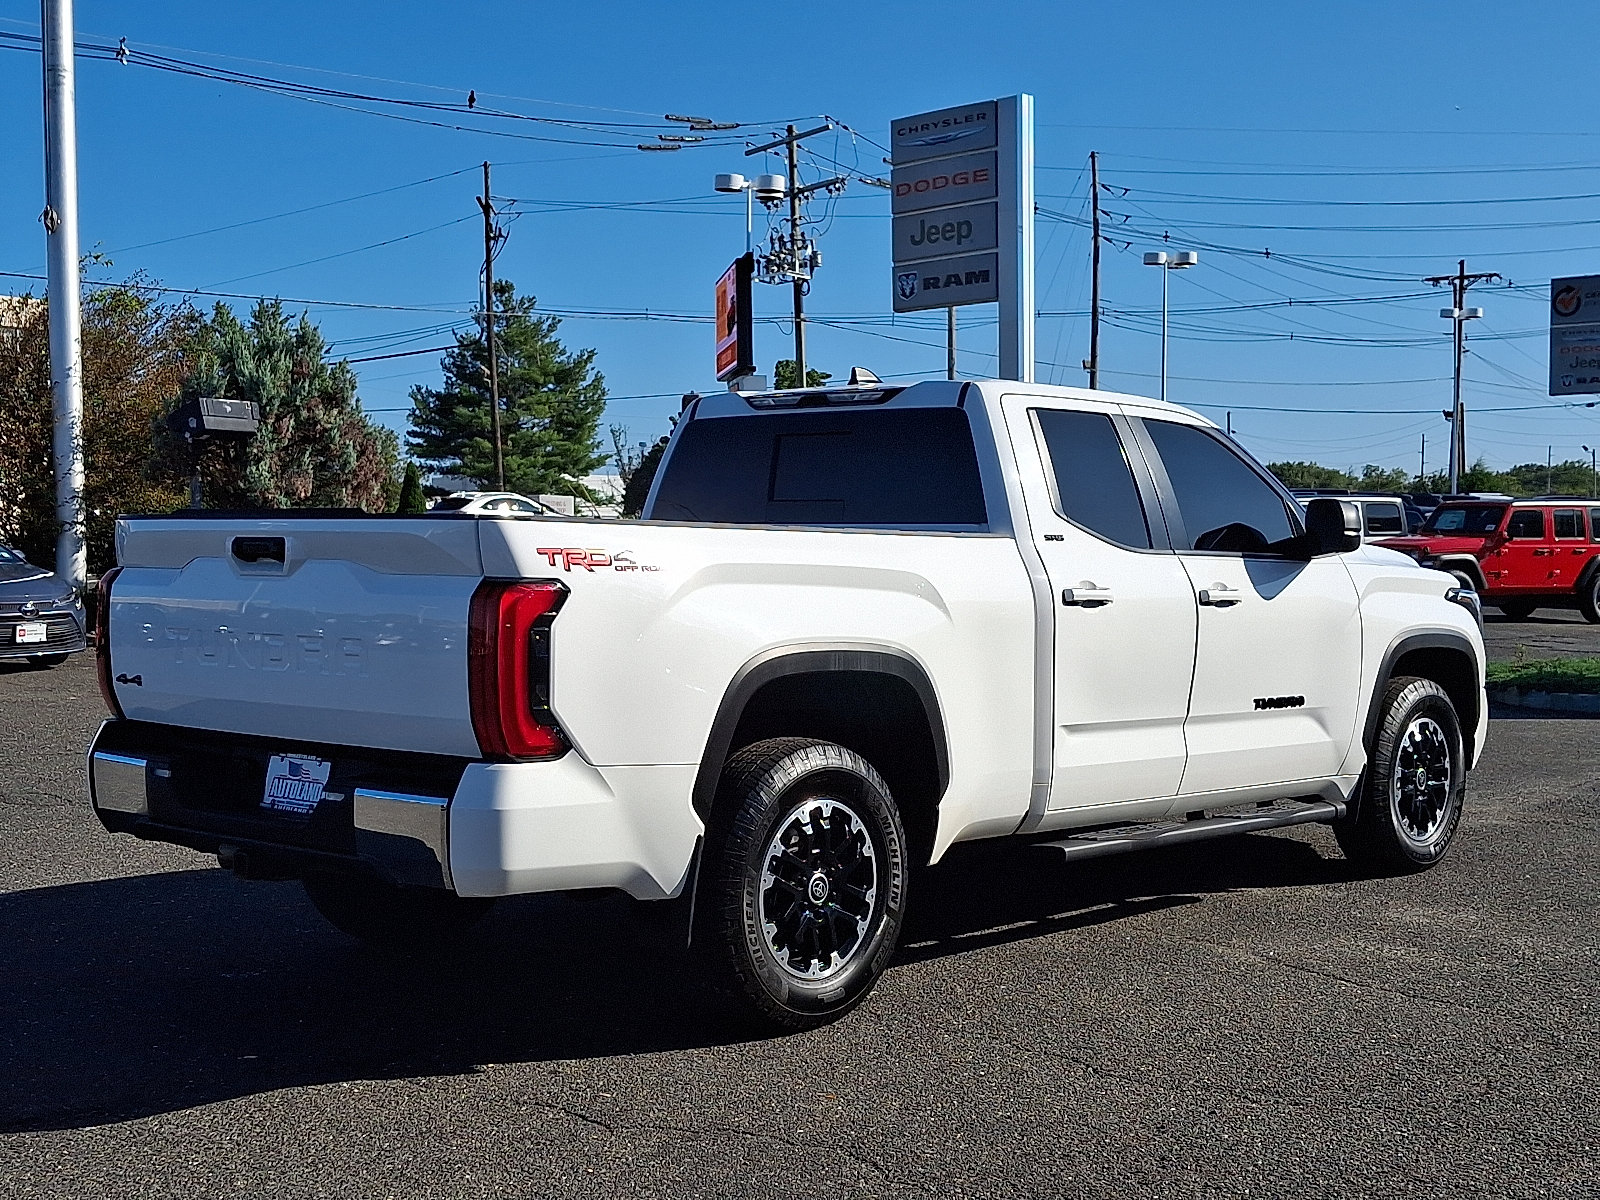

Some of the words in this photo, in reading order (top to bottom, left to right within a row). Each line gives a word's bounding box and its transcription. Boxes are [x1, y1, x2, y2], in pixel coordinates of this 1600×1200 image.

[896, 112, 987, 137] CHRYSLER
[896, 168, 990, 197] DODGE
[910, 219, 973, 246] Jeep
[922, 269, 991, 291] RAM
[536, 548, 613, 572] TRD
[164, 626, 370, 679] TUNDRA
[269, 778, 324, 802] AUTOLAND
[880, 815, 902, 906] MICHELIN
[744, 878, 768, 971] MICHELIN
